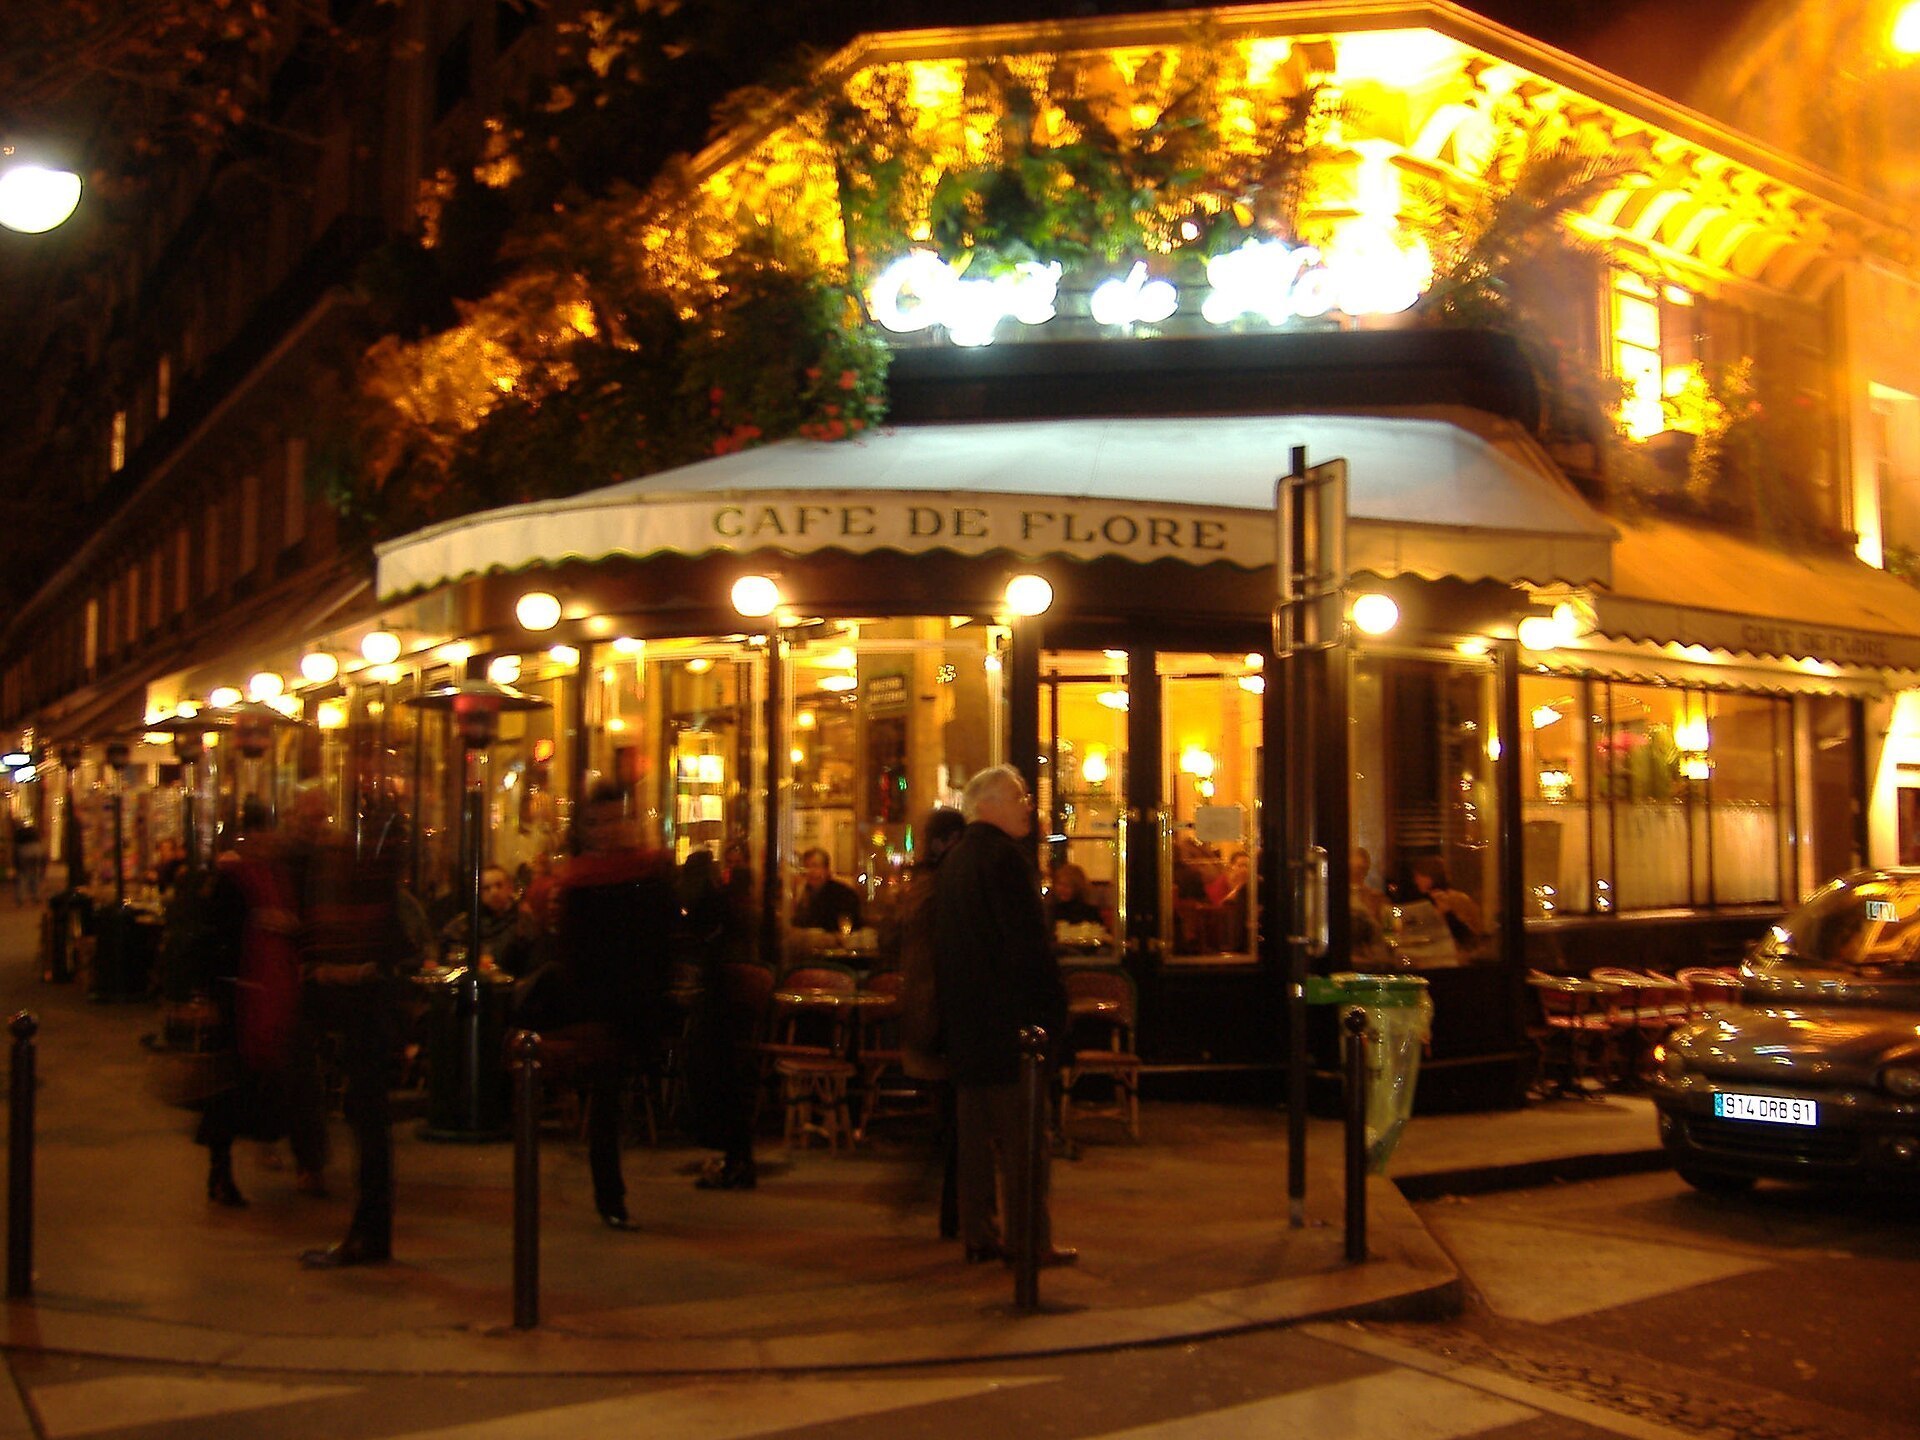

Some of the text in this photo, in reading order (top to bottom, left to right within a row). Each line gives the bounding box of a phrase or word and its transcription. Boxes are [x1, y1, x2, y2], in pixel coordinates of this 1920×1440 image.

[712, 506, 1228, 551] CAFE DE FLORE
[1726, 1096, 1754, 1116] 914
[1792, 1102, 1810, 1121] 91
